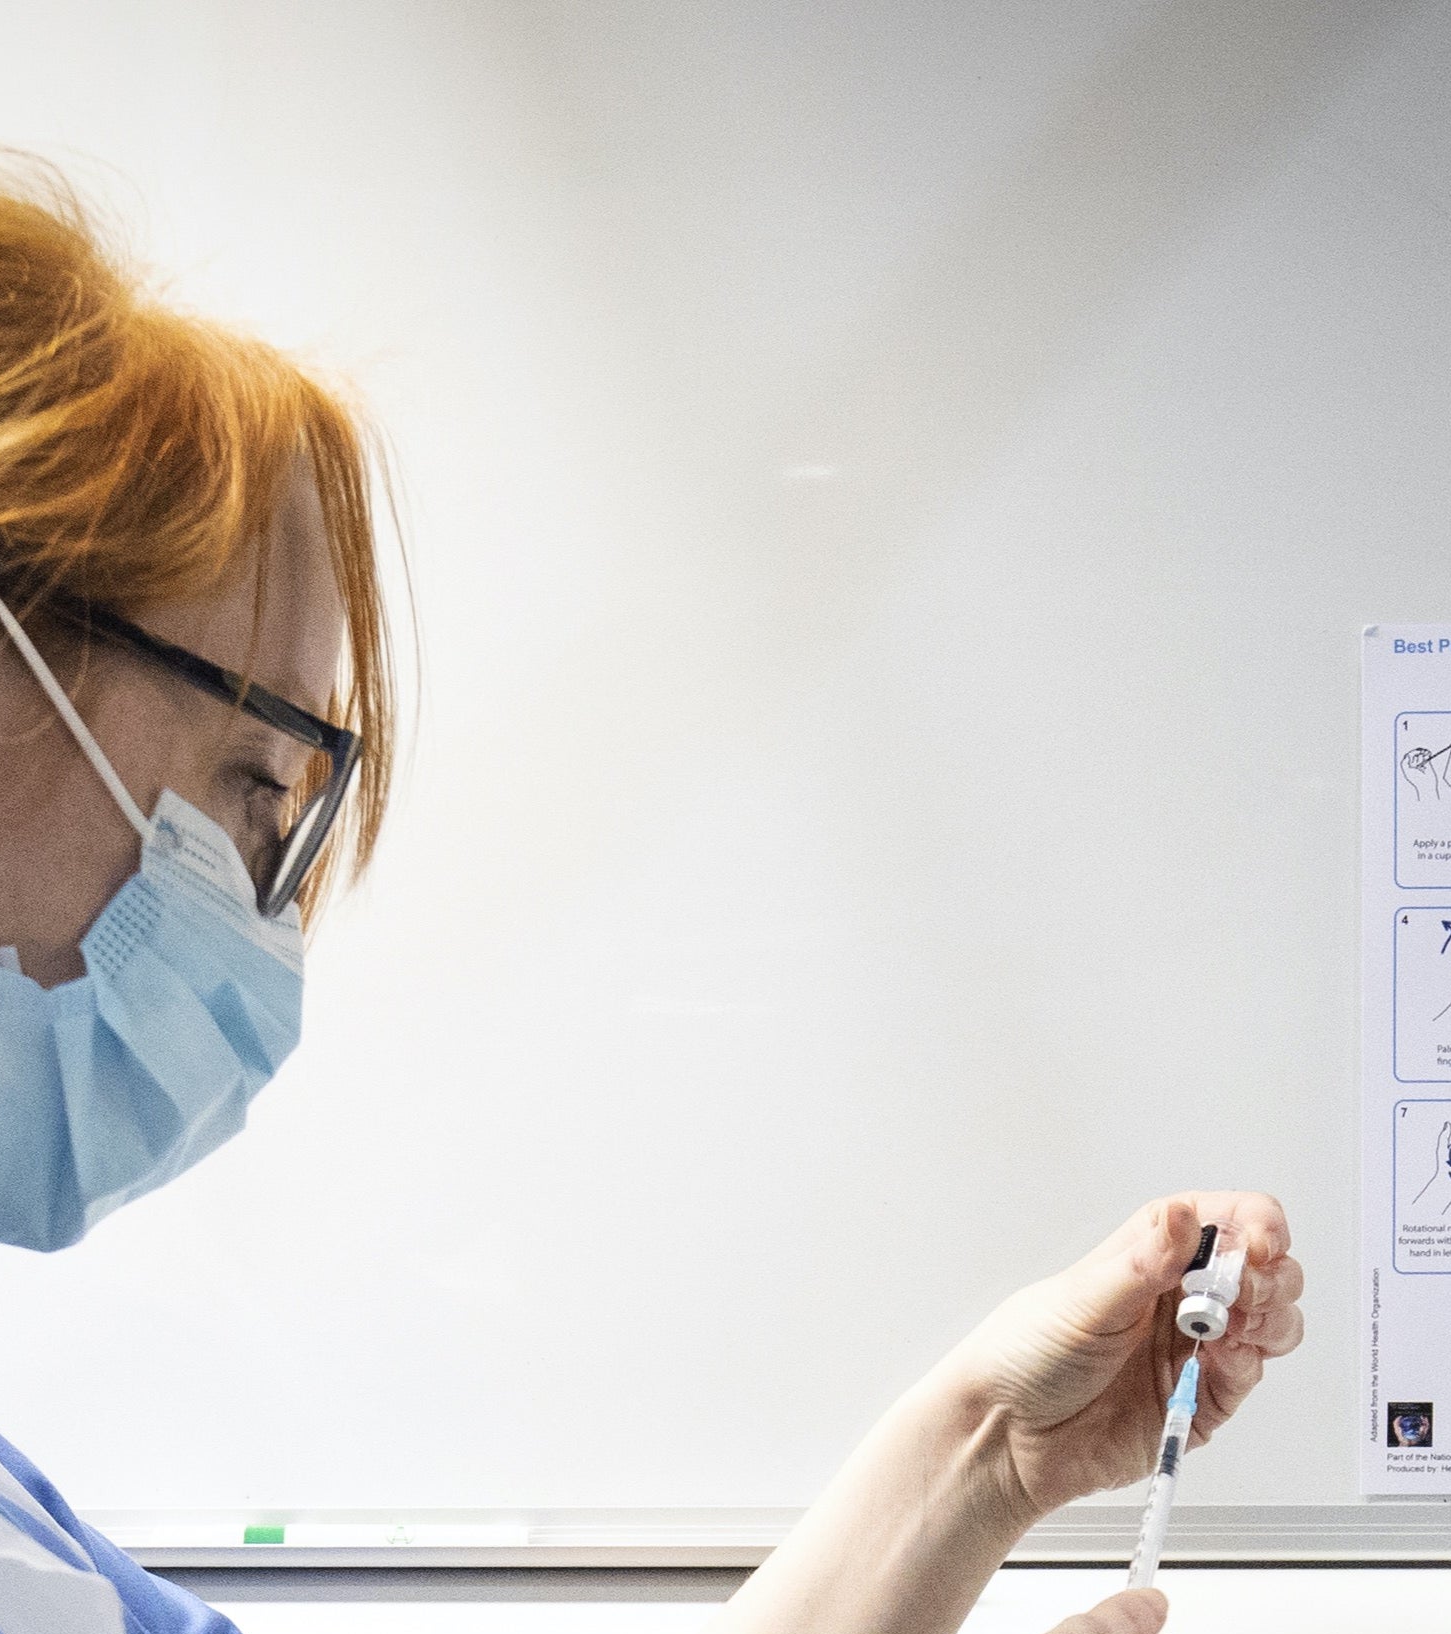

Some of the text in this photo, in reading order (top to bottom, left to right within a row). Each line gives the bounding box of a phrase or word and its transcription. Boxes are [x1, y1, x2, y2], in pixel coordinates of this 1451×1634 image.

[1393, 638, 1434, 654] Best
[1402, 720, 1409, 731] 1
[1412, 838, 1439, 850] Apply
[1401, 914, 1409, 925] 4
[1400, 1106, 1408, 1118] 7
